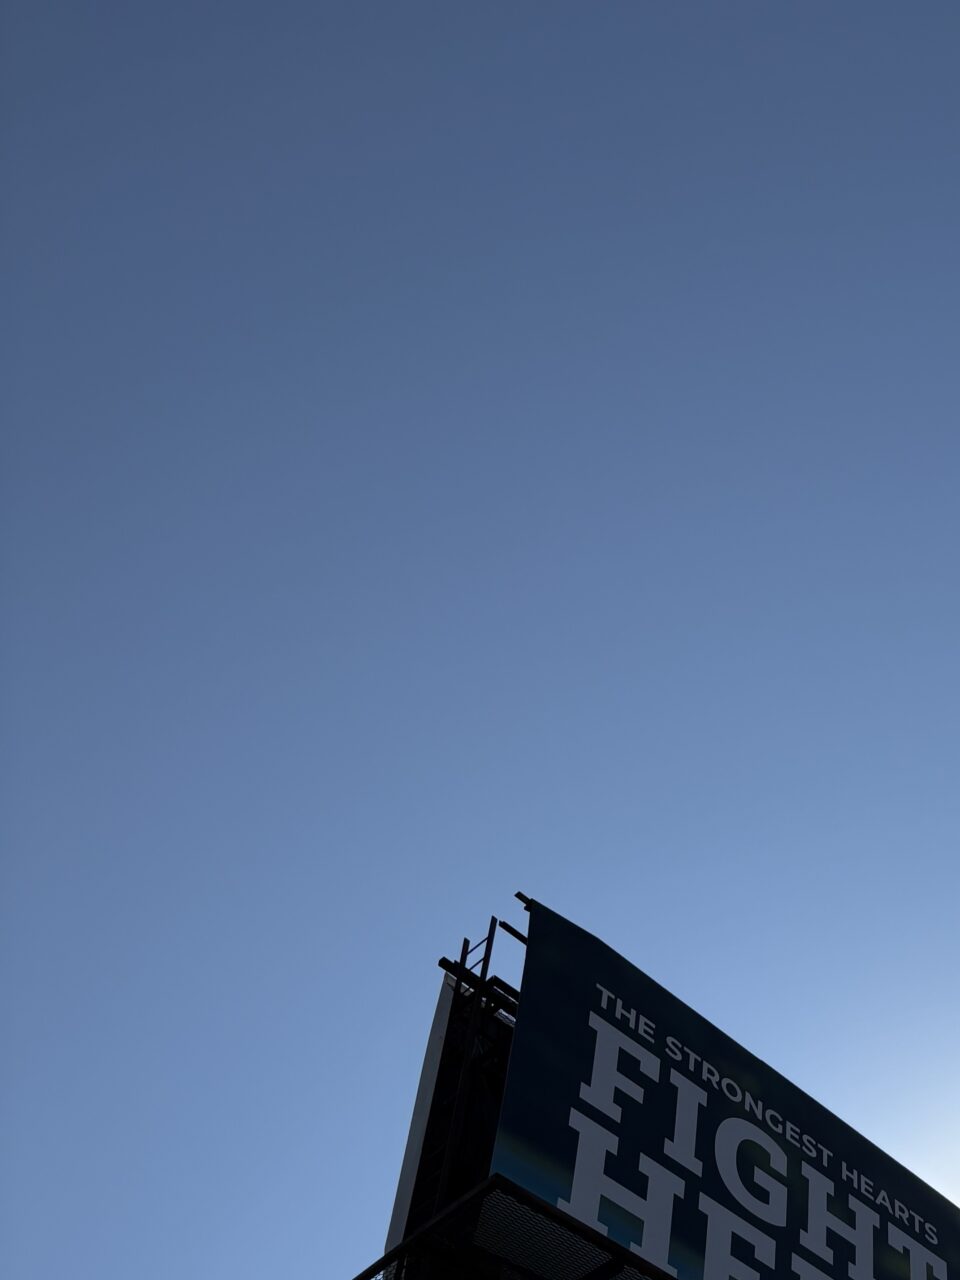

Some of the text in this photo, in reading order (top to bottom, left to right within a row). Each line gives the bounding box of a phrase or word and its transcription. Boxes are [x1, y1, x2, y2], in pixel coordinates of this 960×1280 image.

[595, 981, 939, 1245] THE STRONGEST HEARTS
